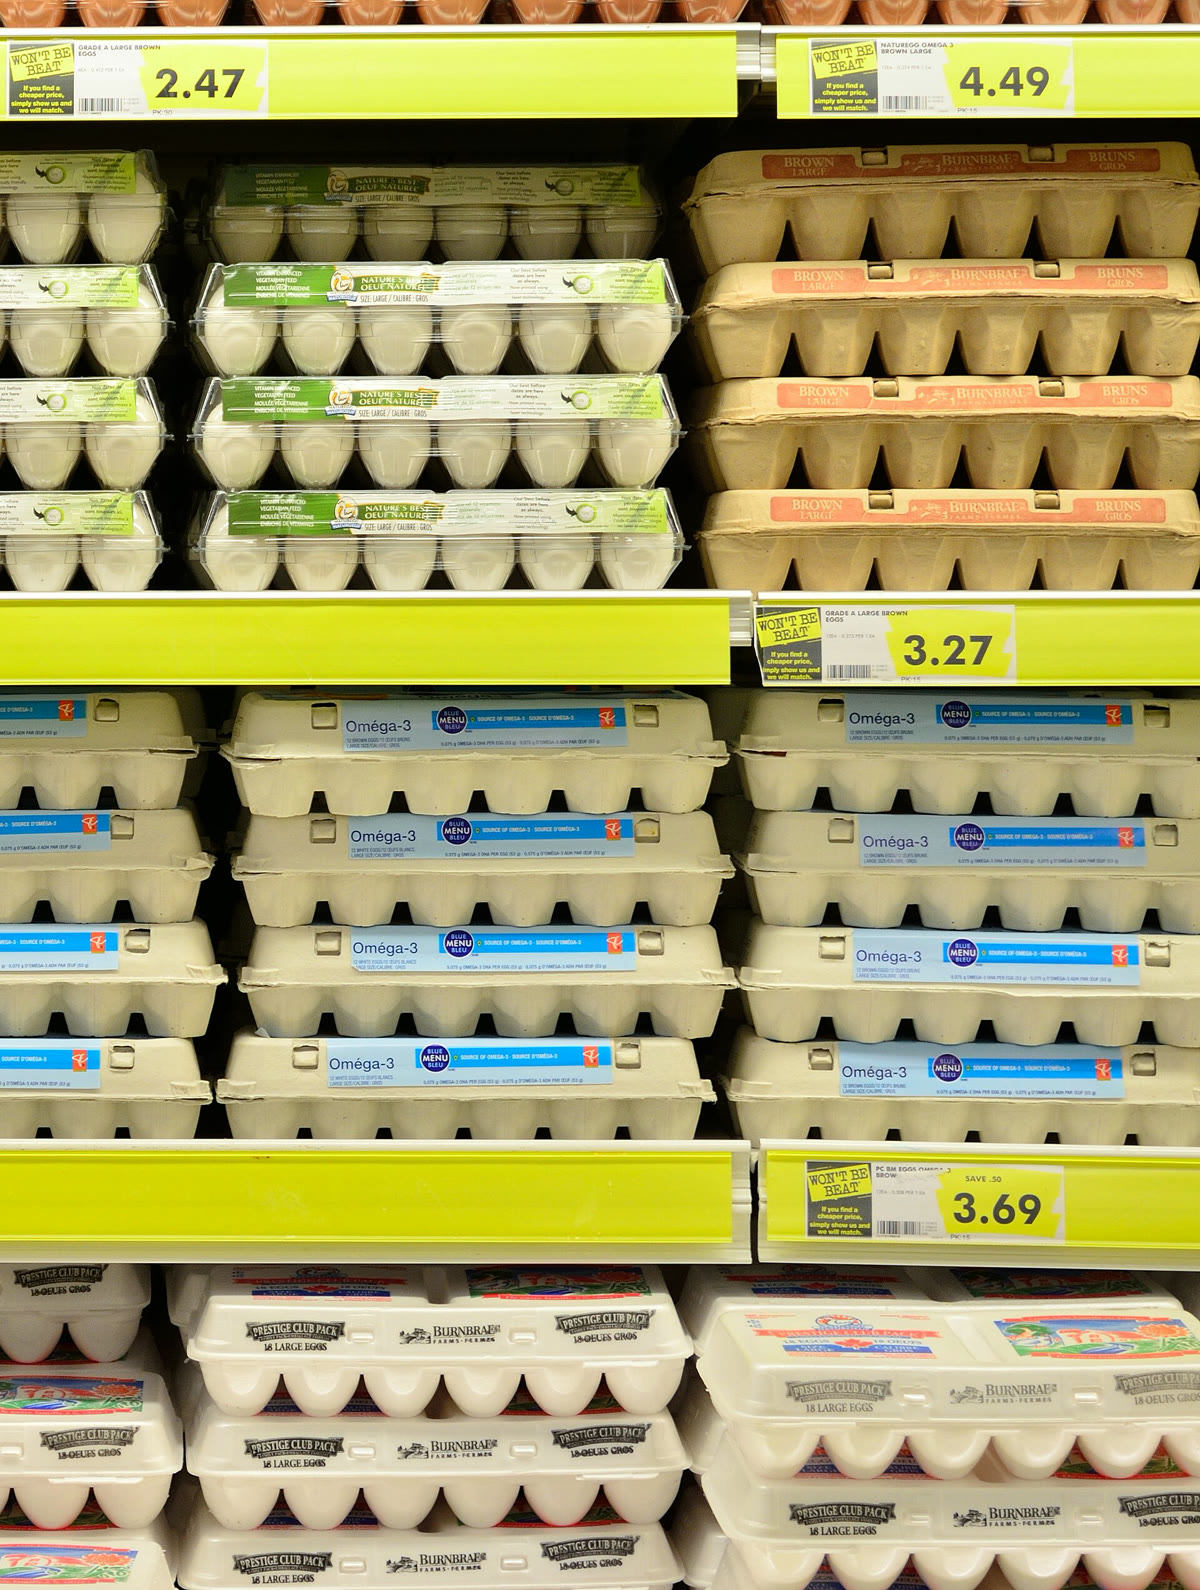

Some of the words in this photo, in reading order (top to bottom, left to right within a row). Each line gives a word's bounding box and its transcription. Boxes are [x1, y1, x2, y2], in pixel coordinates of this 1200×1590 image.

[11, 47, 50, 66] WON'T
[53, 47, 72, 59] BE
[814, 45, 853, 64] WON'T
[856, 44, 874, 56] BE
[26, 61, 61, 76] BEAT
[828, 58, 864, 74] BEAT
[154, 68, 245, 98] 2.47
[959, 66, 1050, 97] 4.49
[783, 156, 835, 168] BROWN
[942, 151, 1013, 166] BURNBRAE
[1089, 151, 1136, 163] BRUNS
[792, 167, 827, 177] LARGE
[1099, 162, 1127, 171] GROS
[799, 386, 850, 398] BROWN
[956, 386, 1028, 400] BURNBRAE
[1102, 385, 1148, 397] BRUNS
[807, 397, 842, 406] LARGE
[1112, 396, 1140, 405] GROS
[758, 615, 796, 631] WON'T
[799, 612, 818, 625] BE
[773, 626, 808, 642] BEAT
[903, 635, 993, 666] 3.27
[849, 712, 915, 727] Oméga-3
[345, 720, 412, 734] Oméga-3
[351, 830, 416, 844] Oméga-3
[443, 826, 471, 835] MENU
[856, 949, 922, 964] Oméga-3
[949, 948, 977, 958] MENU
[329, 1057, 395, 1072] Oméga-3
[809, 1170, 847, 1186] WON'T
[850, 1168, 869, 1180] BE
[965, 1175, 987, 1183] SAVE
[824, 1181, 859, 1197] BEAT
[953, 1193, 1042, 1225] 3.69
[253, 1323, 292, 1337] PRESTIGE
[292, 1322, 315, 1333] CLUB
[316, 1324, 338, 1337] PACK
[264, 1343, 273, 1351] 18
[274, 1343, 303, 1351] LARGE
[304, 1342, 327, 1351] EGGS
[793, 1382, 835, 1397] PRESTIGE
[836, 1382, 859, 1393] CLUB
[860, 1383, 883, 1396] PACK
[985, 1383, 1051, 1396] BURNBRAE
[1134, 1397, 1144, 1405] 18
[1145, 1395, 1176, 1405] OEUFS
[806, 1404, 816, 1413] 18
[817, 1403, 848, 1413] LARGE
[849, 1402, 874, 1412] EGGS
